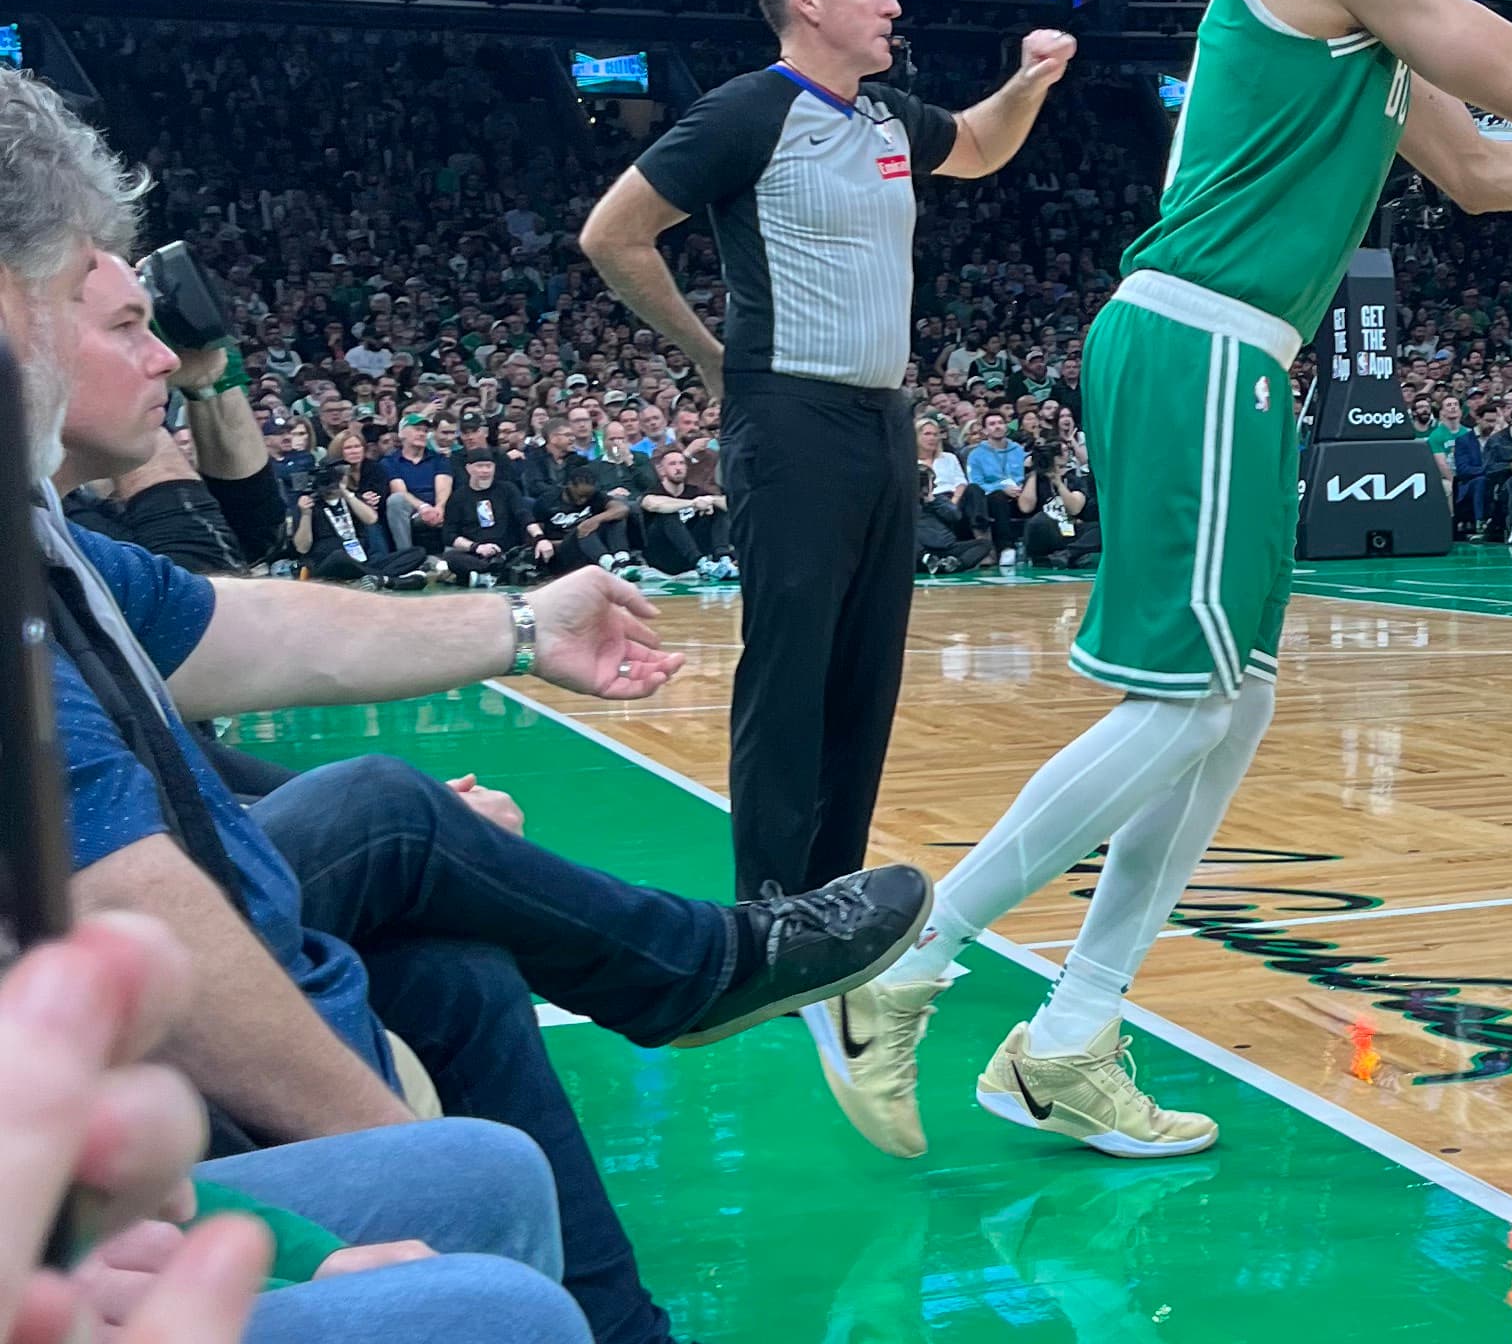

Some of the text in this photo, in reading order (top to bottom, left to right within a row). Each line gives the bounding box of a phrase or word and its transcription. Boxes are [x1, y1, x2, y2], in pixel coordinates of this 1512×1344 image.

[1360, 305, 1385, 328] GET
[1361, 328, 1387, 351] THE
[1369, 351, 1393, 380] App
[1348, 407, 1405, 429] Google
